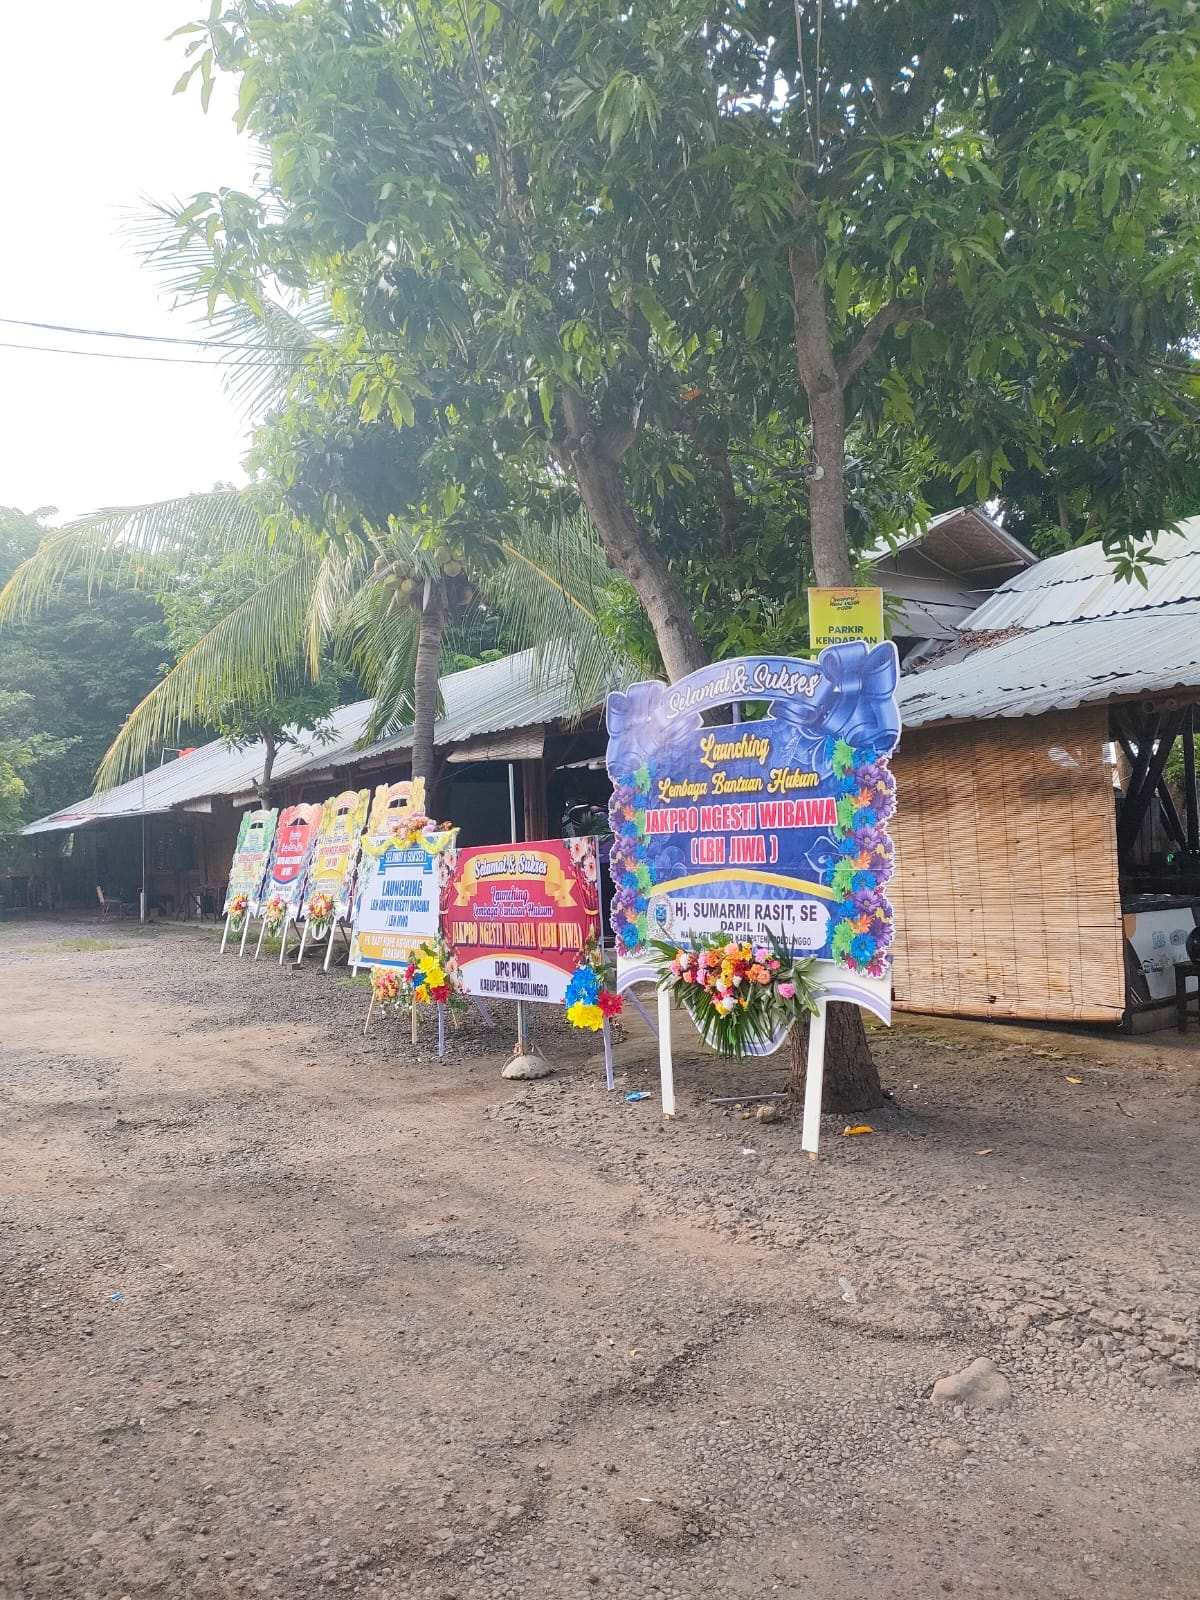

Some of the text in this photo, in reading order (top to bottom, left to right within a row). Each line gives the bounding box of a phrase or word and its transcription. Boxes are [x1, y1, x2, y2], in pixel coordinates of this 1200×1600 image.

[828, 625, 863, 634] PARKIR
[667, 664, 823, 718] Selamat & Sukses
[700, 733, 770, 768] Launching
[658, 767, 820, 803] Lembaga Bantuan Hukum
[645, 797, 838, 833] JAKPRO NGESTI WIBAWA
[729, 835, 766, 863] JIWA
[474, 855, 507, 878] Selamat
[518, 854, 548, 875] Sukses
[382, 879, 423, 897] LAUNCHING
[675, 902, 690, 920] Hj.
[693, 902, 750, 919] SUMARMI
[755, 904, 795, 924] RASIT,
[800, 905, 817, 921] SE
[721, 921, 753, 932] DAPIL
[495, 960, 530, 979] DPC PKDI
[480, 979, 548, 997] KABUPATEN PROBOLINGGO
